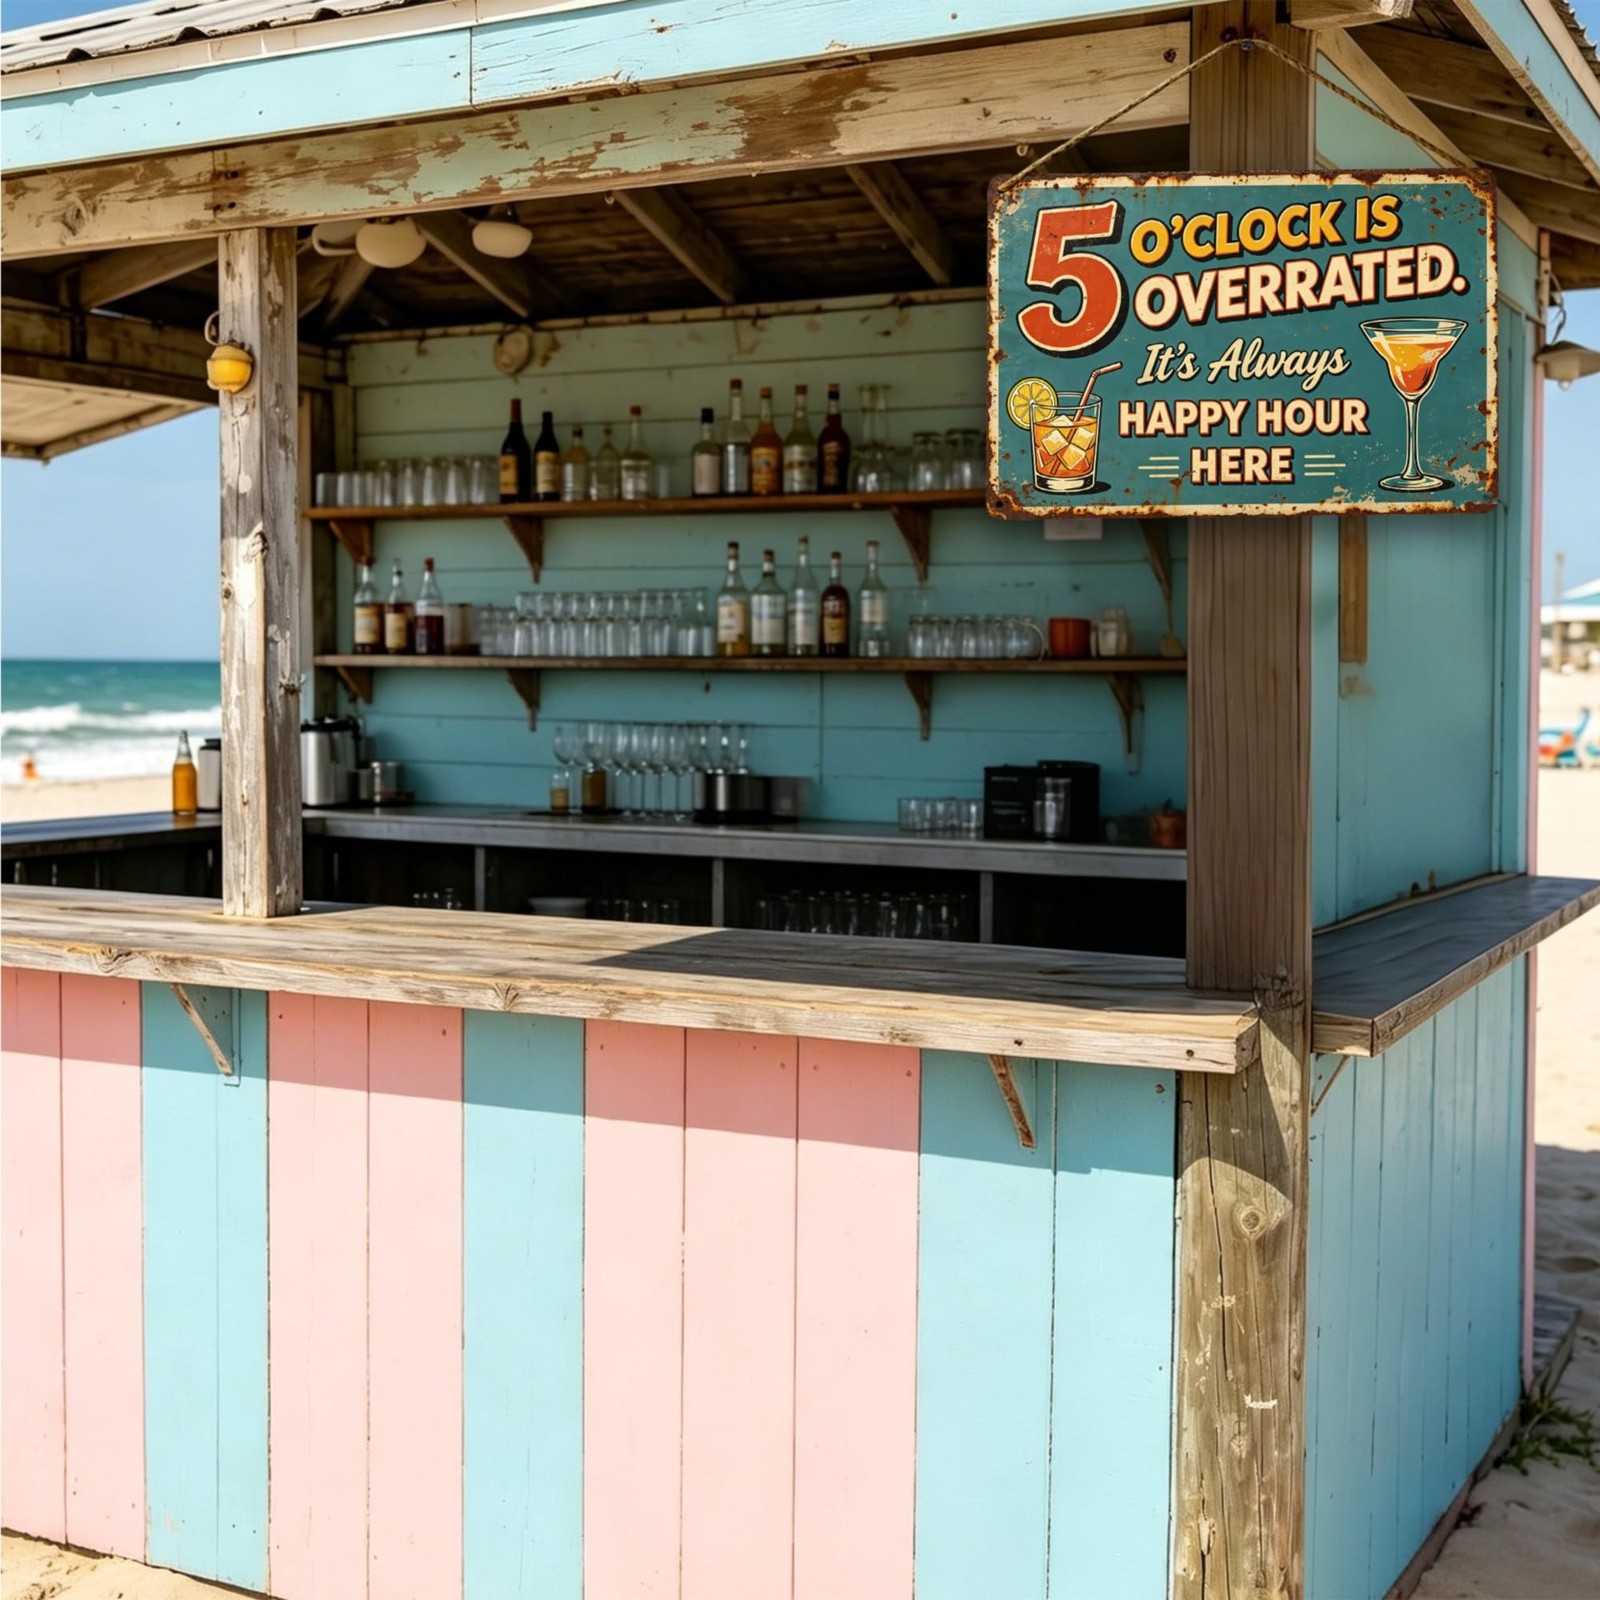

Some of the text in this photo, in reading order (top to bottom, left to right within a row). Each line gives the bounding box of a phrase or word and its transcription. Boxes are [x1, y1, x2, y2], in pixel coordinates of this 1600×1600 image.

[1017, 195, 1402, 356] 5 O'CLOCK IS
[1134, 243, 1469, 328] OVERRATED.
[1136, 338, 1350, 391] It's Always
[1119, 399, 1369, 437] HAPPY HOUR
[1190, 448, 1294, 485] HERE
